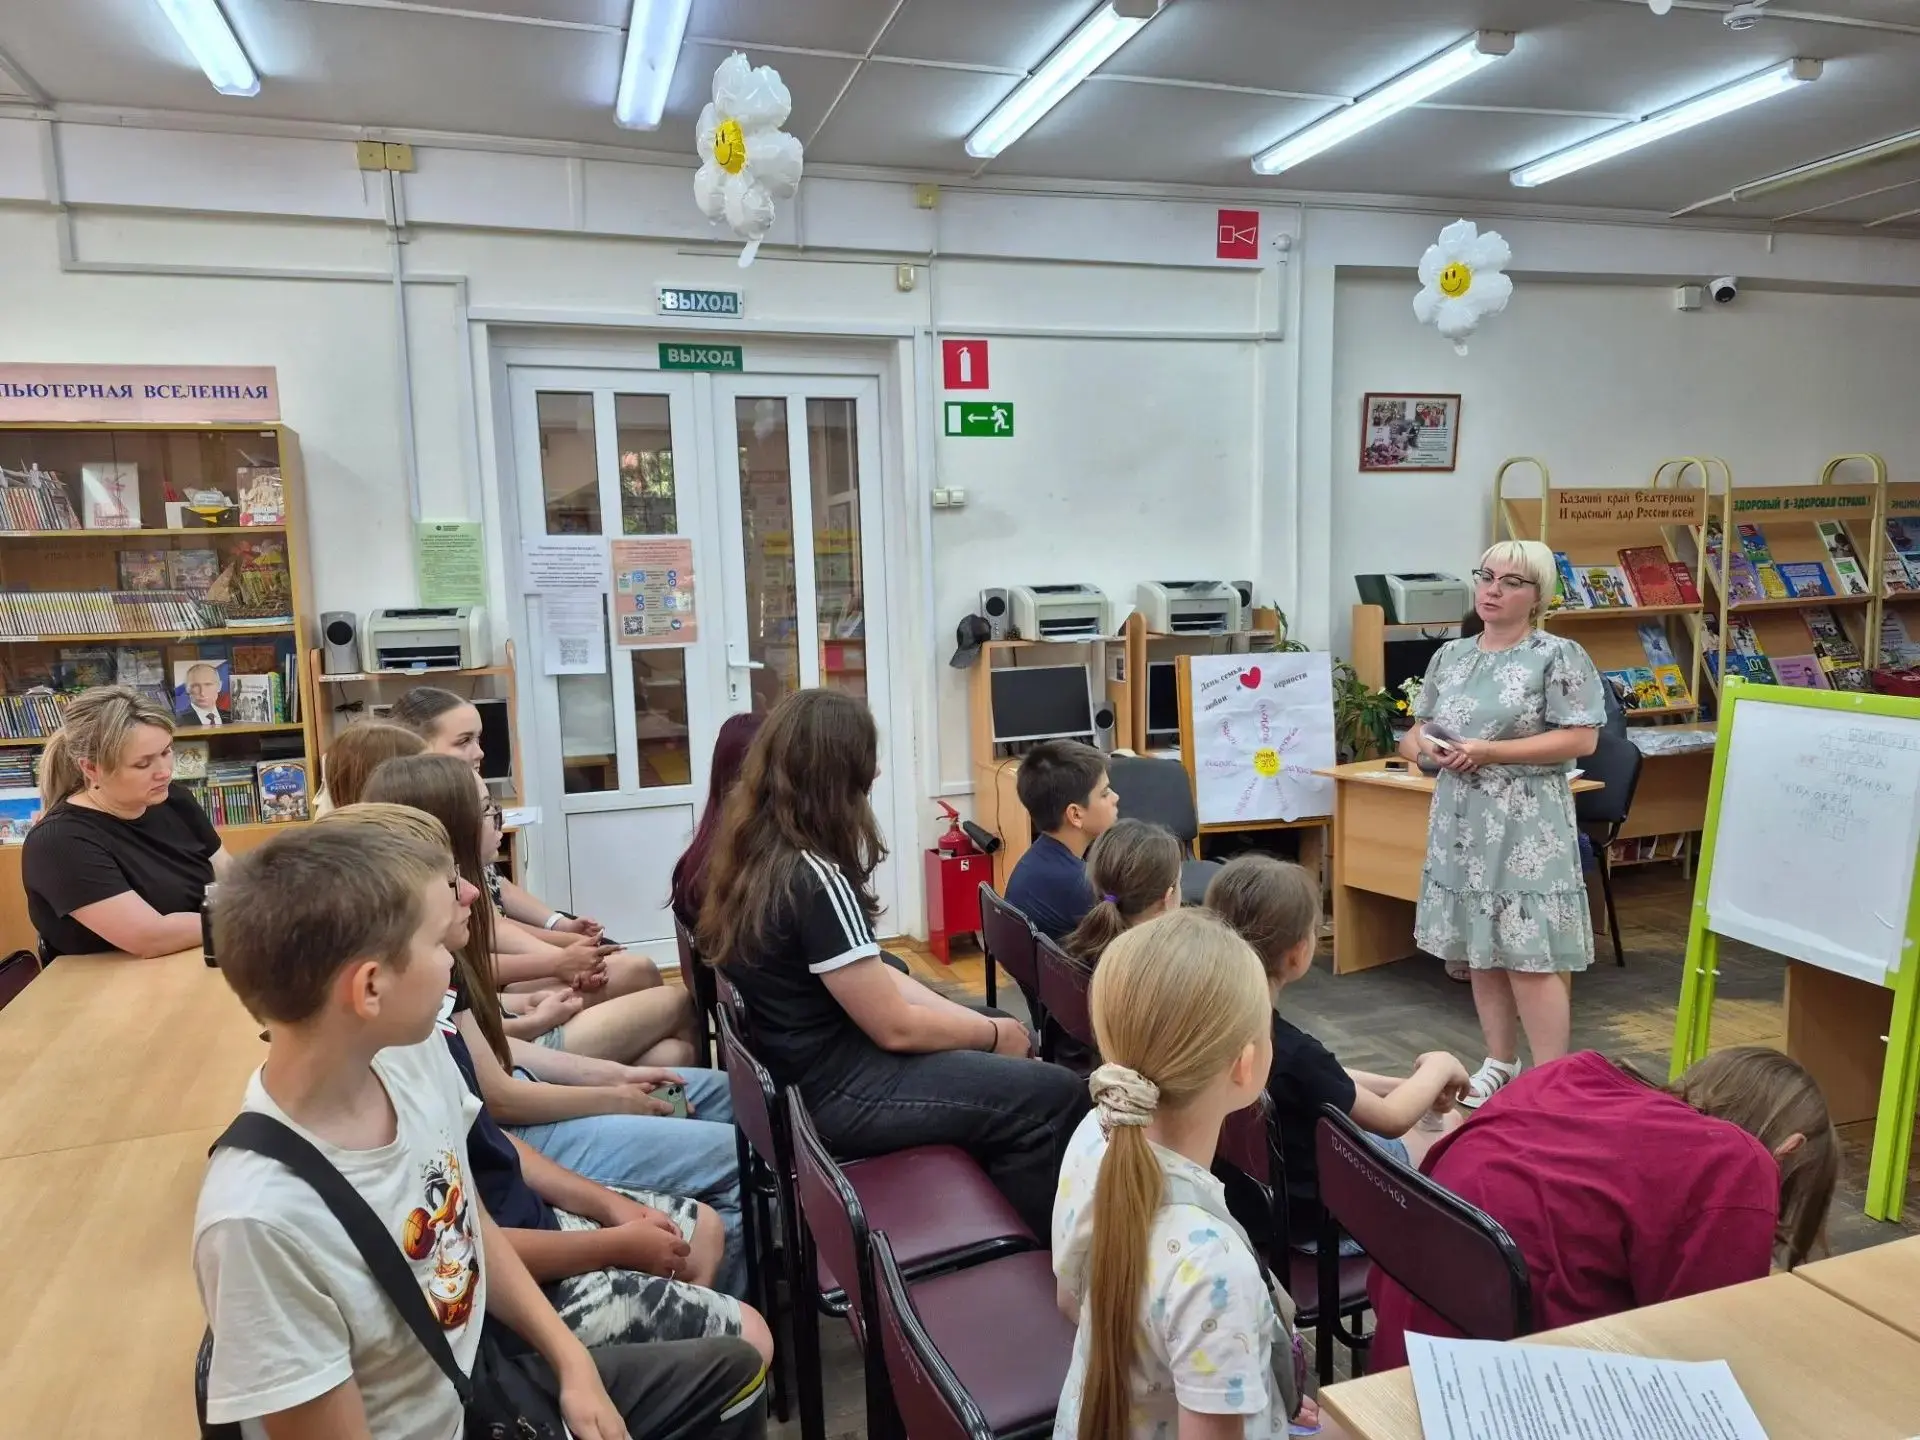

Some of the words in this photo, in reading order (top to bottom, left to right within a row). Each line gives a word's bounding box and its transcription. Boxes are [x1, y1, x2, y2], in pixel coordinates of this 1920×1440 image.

[664, 291, 735, 312] ВЫХОД
[667, 348, 736, 367] ВЫХОД
[144, 384, 268, 399] ВСЕЛЕННАЯ
[1559, 492, 1602, 504] Казачий
[1607, 493, 1630, 506] край
[1634, 491, 1695, 505] Екатерины
[1733, 497, 1781, 512] ЗДОРОВЫЙ
[1559, 507, 1568, 520] И
[1571, 508, 1612, 522] красный
[1616, 509, 1634, 521] дар
[1636, 507, 1670, 519] России
[1745, 658, 1765, 672] 101
[1201, 678, 1220, 692] День
[1204, 694, 1229, 712] любви
[1273, 672, 1308, 689] верности
